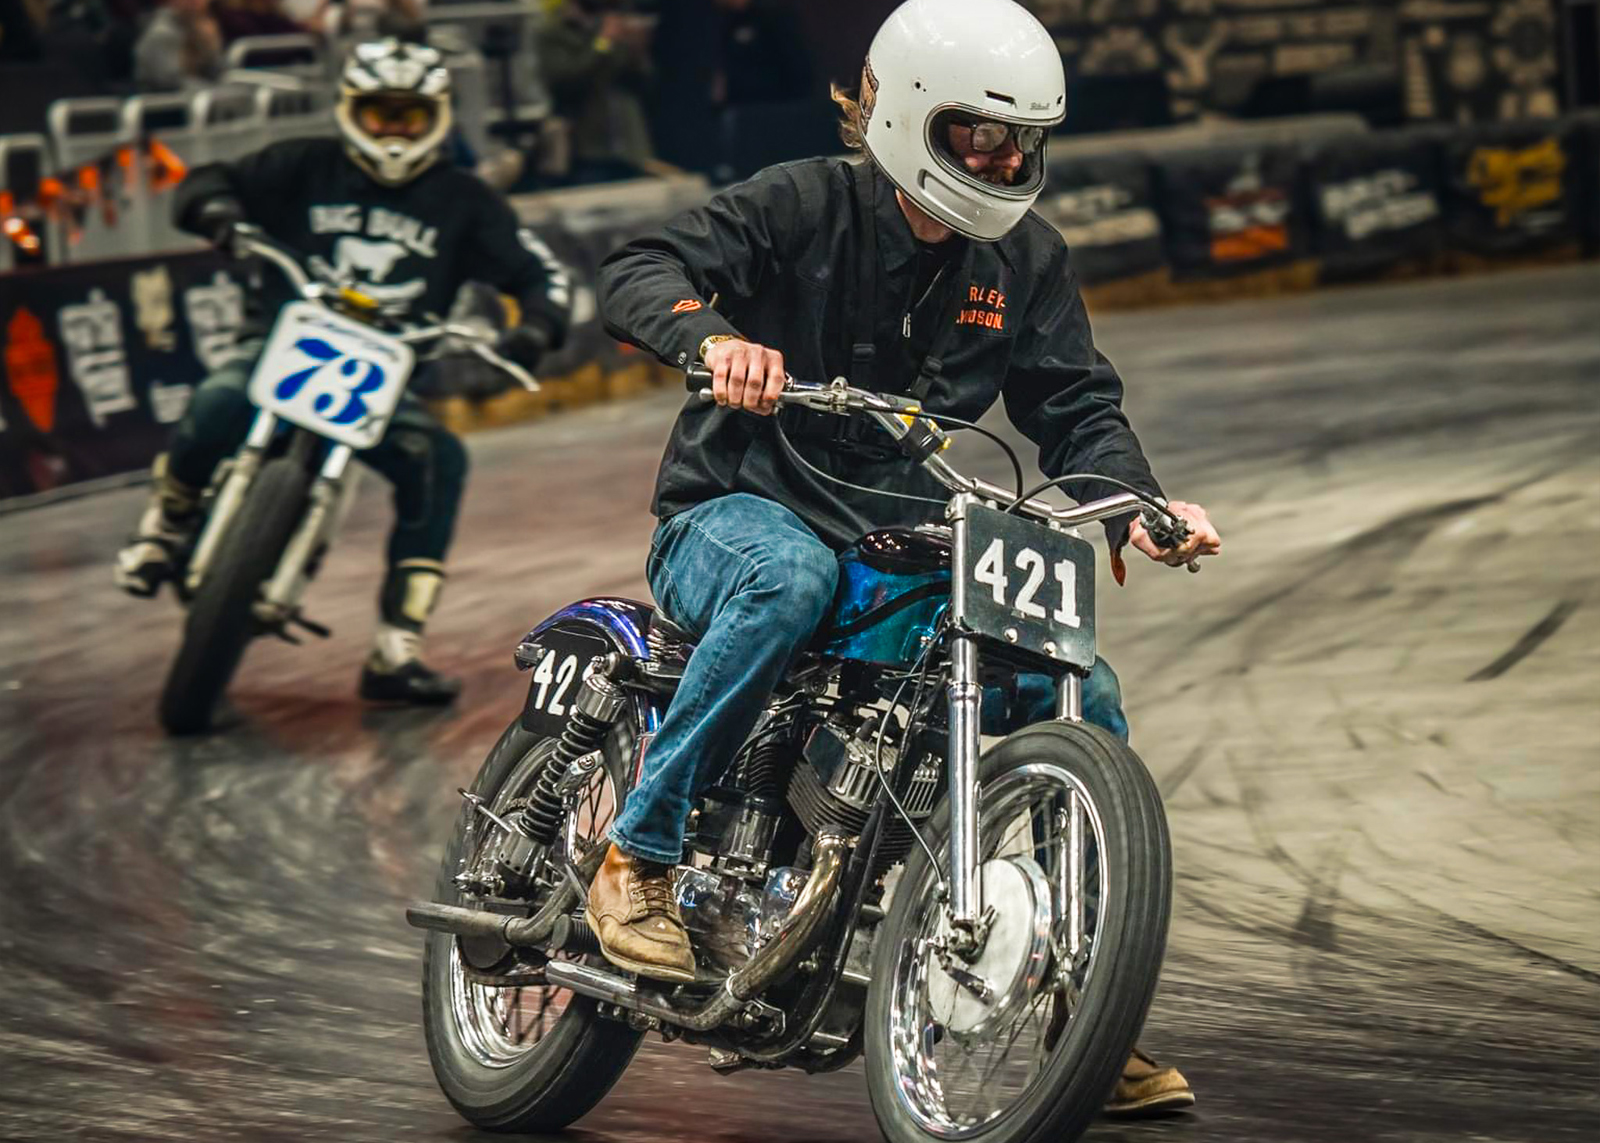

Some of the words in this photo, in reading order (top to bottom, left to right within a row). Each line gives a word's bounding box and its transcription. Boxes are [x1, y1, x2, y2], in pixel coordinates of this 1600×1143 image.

[956, 309, 1003, 330] VIDSON
[274, 338, 386, 425] 73
[974, 538, 1081, 629] 421
